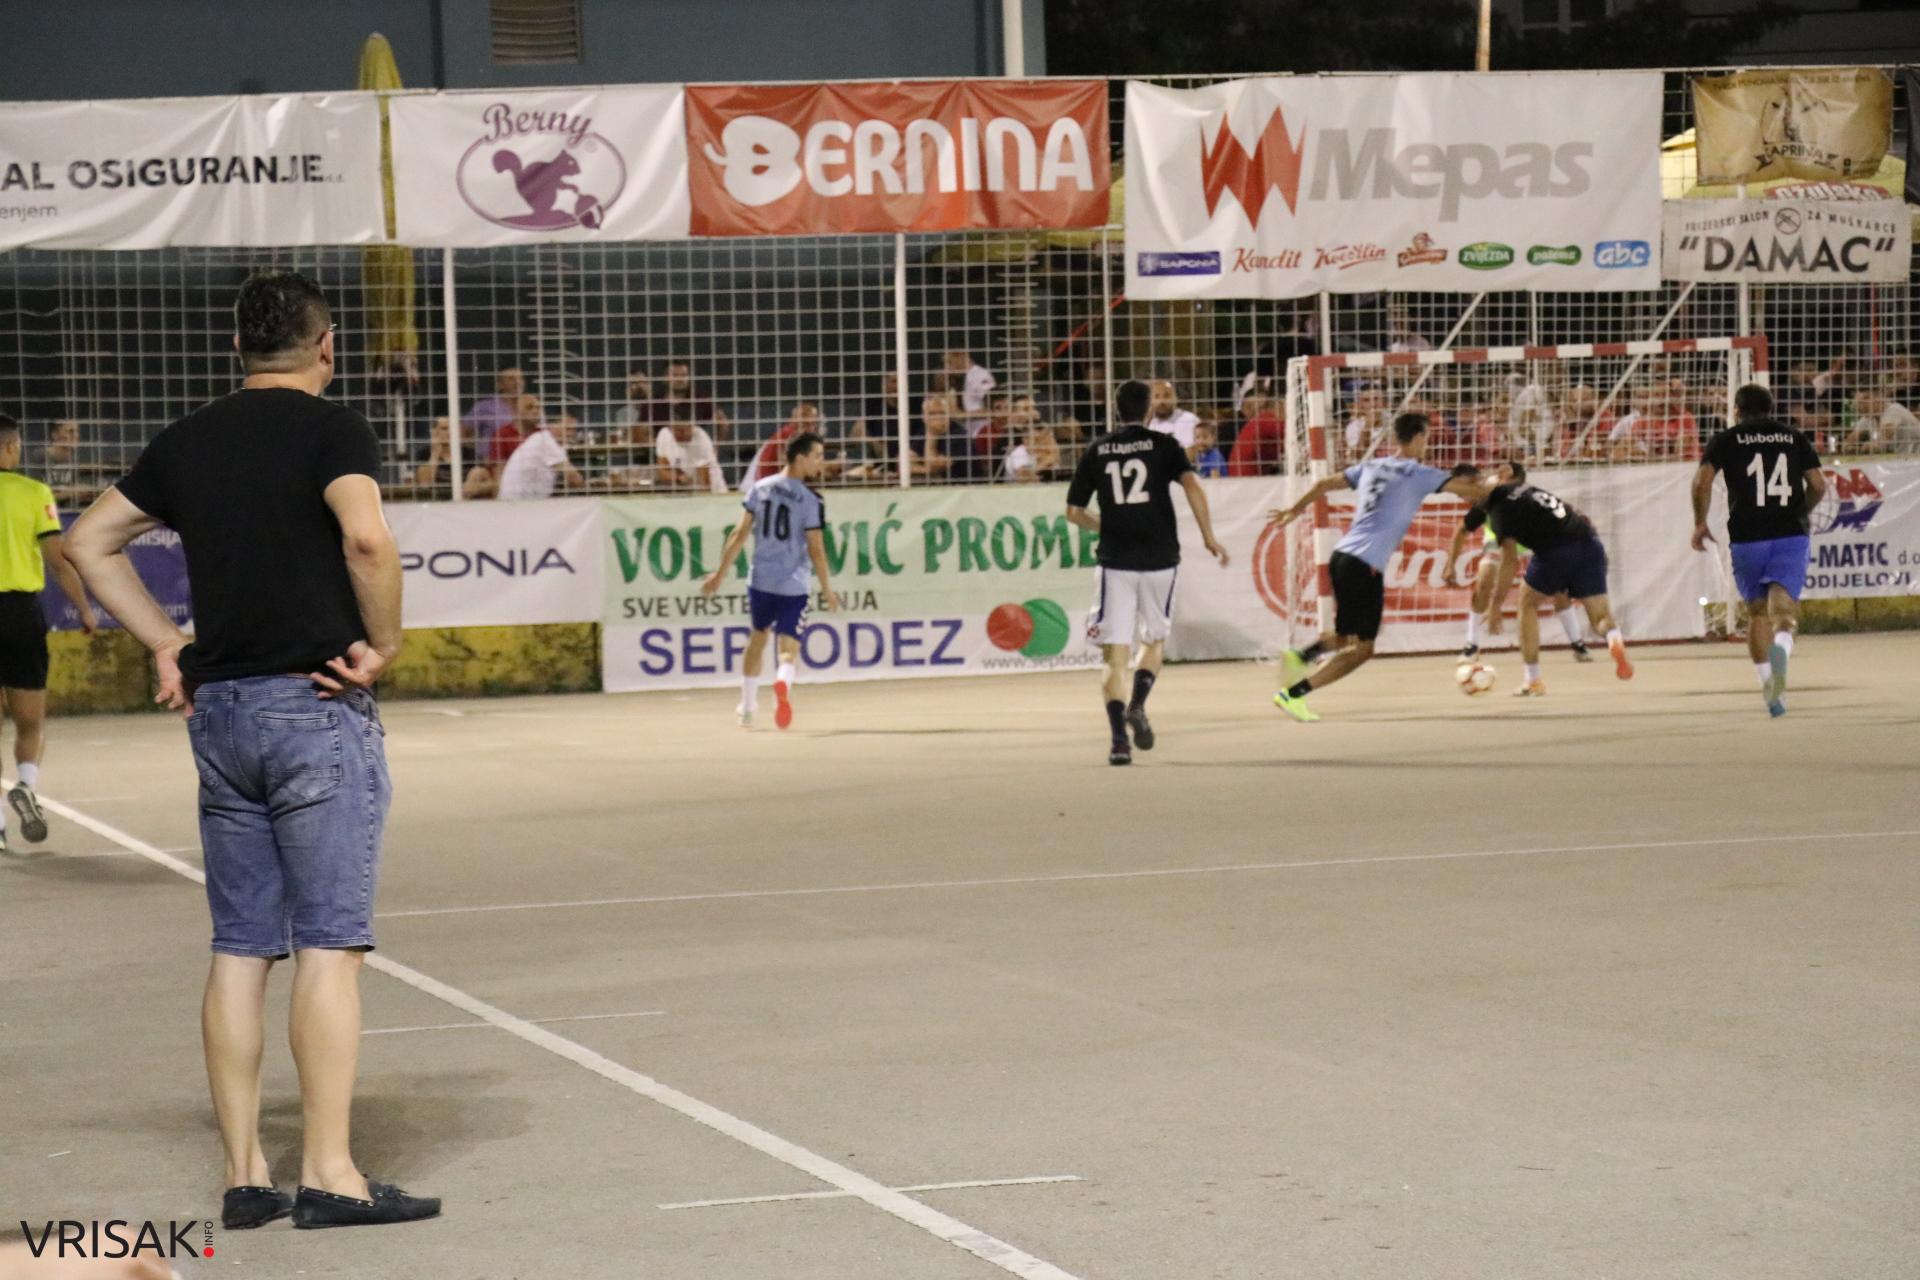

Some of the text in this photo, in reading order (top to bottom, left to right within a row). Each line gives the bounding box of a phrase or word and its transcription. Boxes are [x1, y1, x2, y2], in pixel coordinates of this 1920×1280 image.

[483, 103, 592, 147] Berny
[2, 162, 54, 190] AL
[68, 153, 324, 189] OSIGURANJE
[704, 115, 1094, 206] BERNINA
[1308, 127, 1594, 222] Mepas
[1807, 211, 1821, 221] ZA
[1232, 248, 1302, 272] Kandit
[1597, 242, 1645, 264] abc
[1105, 458, 1150, 505] 12
[1747, 452, 1792, 507] 14
[623, 596, 669, 619] SVE
[675, 594, 752, 618] VRSTE
[639, 618, 965, 676] SEPODEZ
